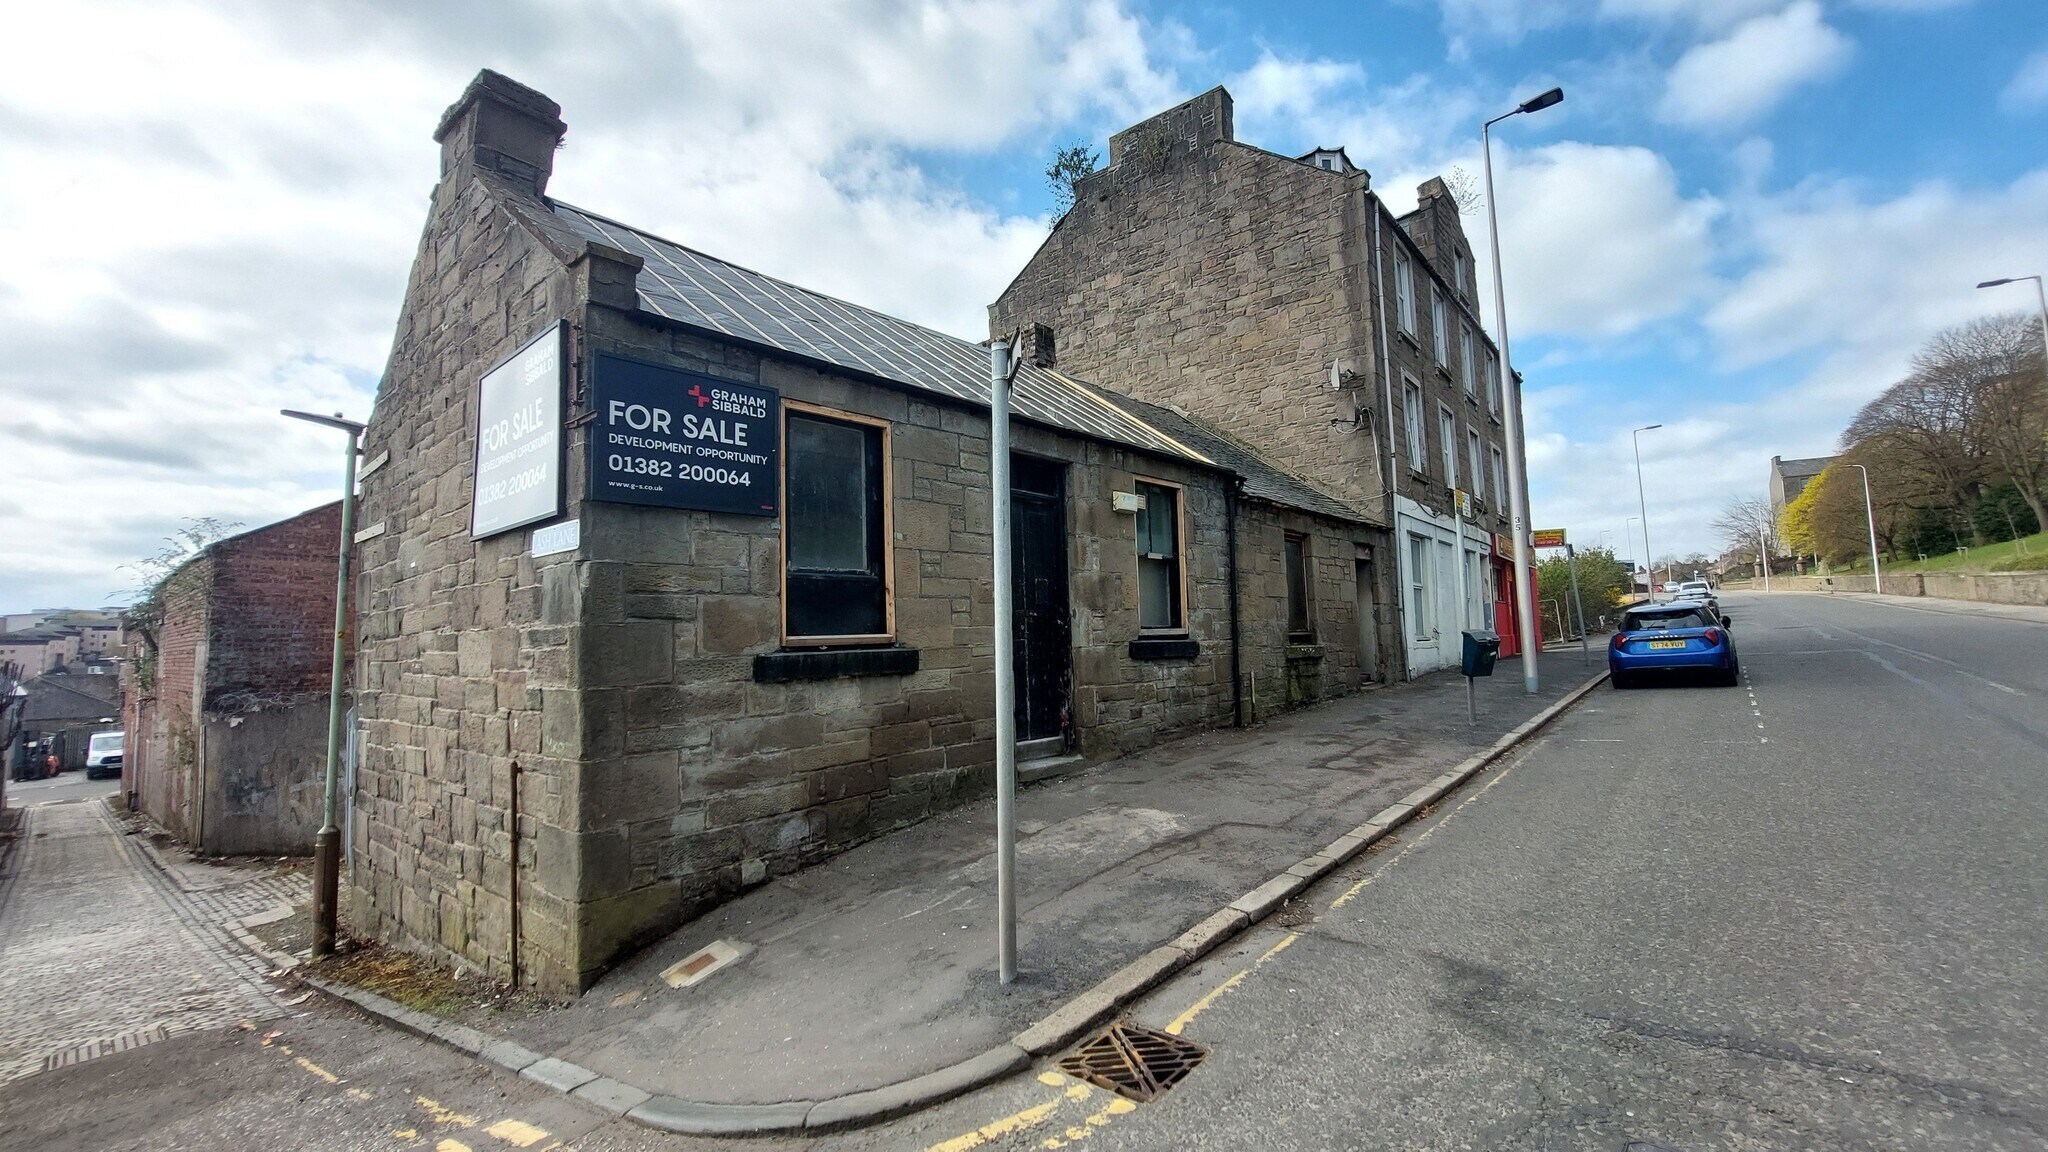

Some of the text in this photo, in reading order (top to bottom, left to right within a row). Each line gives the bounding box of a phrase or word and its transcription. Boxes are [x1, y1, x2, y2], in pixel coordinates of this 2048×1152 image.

[711, 388, 766, 409] GRAHAM
[711, 400, 766, 419] SIBBALD
[482, 397, 544, 456] FOR SALE
[609, 400, 748, 447] FOR SALE
[608, 433, 768, 466] DEVELOPMENT OPPORTUNITY
[478, 462, 547, 506] 01382 200064
[608, 454, 751, 487] 01382 200064
[608, 480, 664, 492] www.g-s.co.uk
[535, 527, 576, 550] ASH LANE
